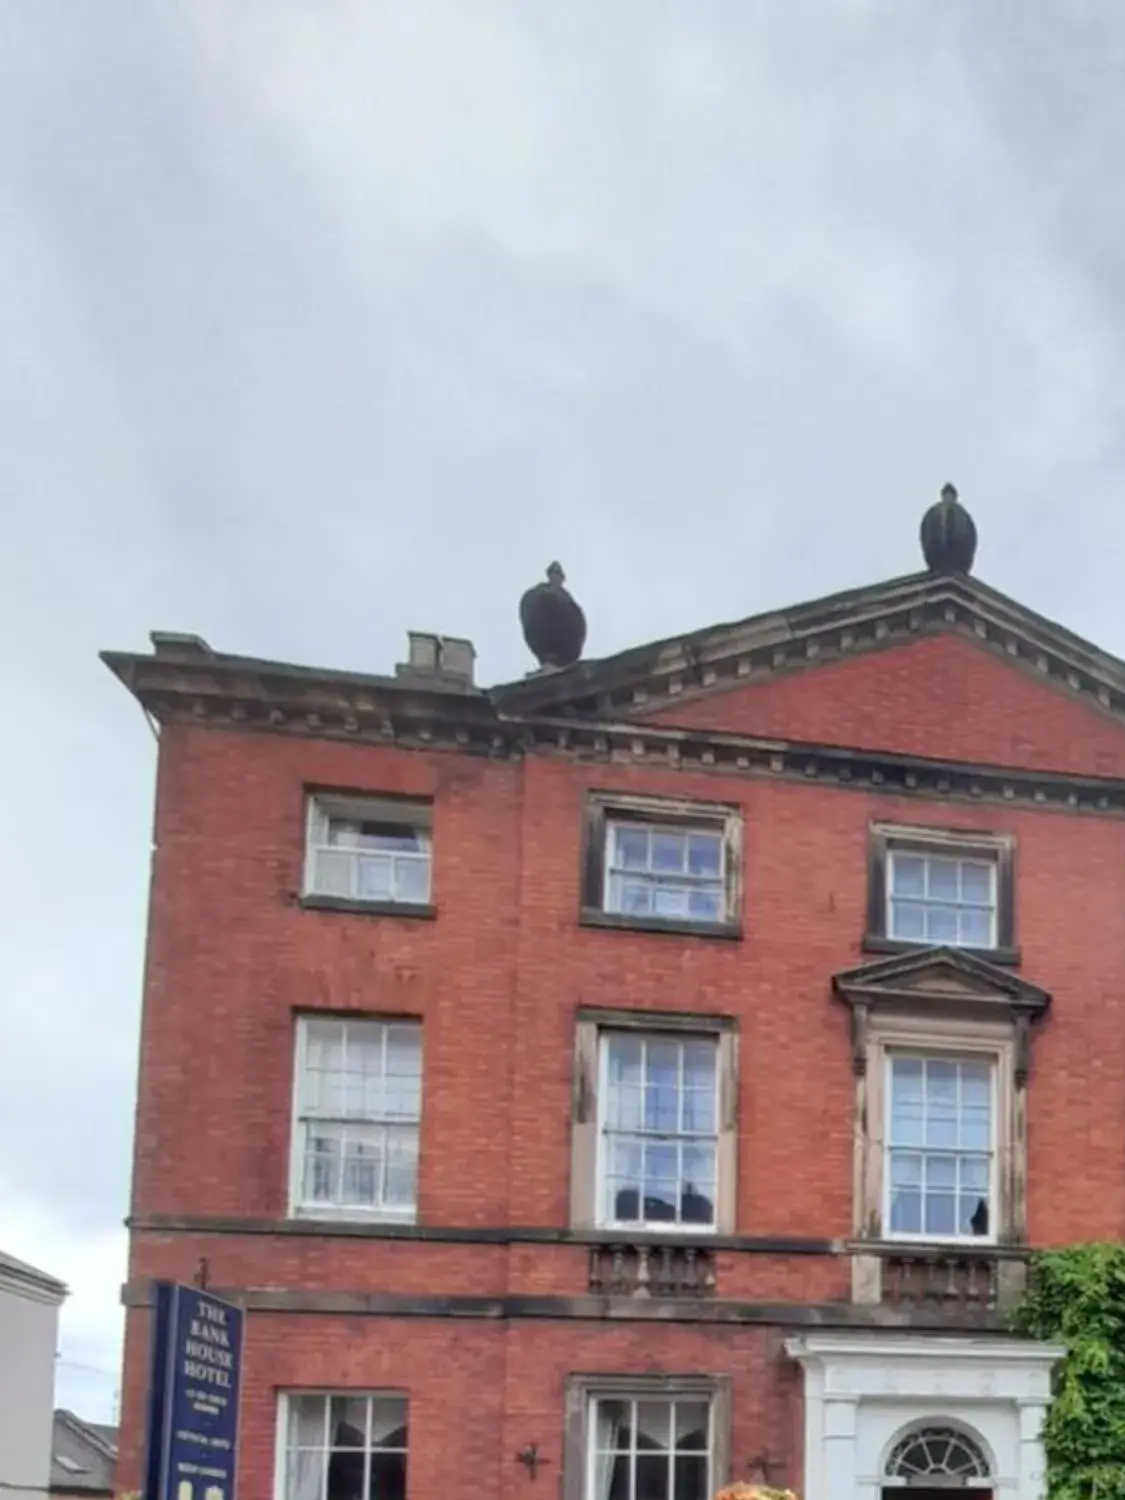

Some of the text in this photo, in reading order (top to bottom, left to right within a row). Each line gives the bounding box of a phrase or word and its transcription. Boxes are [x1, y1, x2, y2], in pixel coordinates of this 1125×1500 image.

[198, 1301, 227, 1326] THE
[191, 1319, 231, 1348] BANK
[185, 1340, 233, 1369] HOUSE
[183, 1360, 231, 1388] HOTEL
